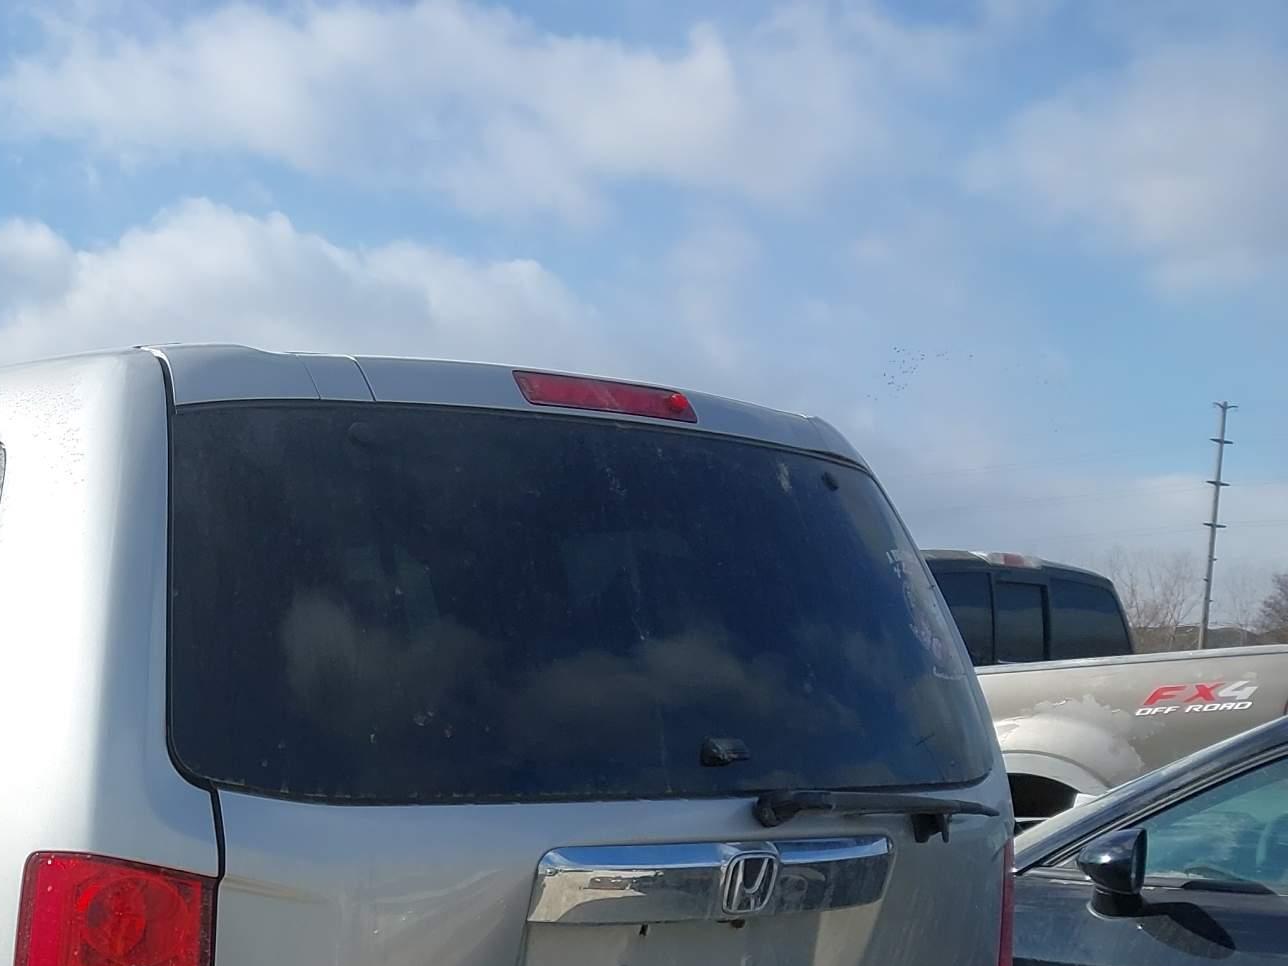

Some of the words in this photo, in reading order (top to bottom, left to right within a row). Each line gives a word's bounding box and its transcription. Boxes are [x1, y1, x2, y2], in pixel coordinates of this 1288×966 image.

[1143, 680, 1258, 706] FX4
[1135, 705, 1181, 716] OFF
[1184, 701, 1253, 713] ROAD
